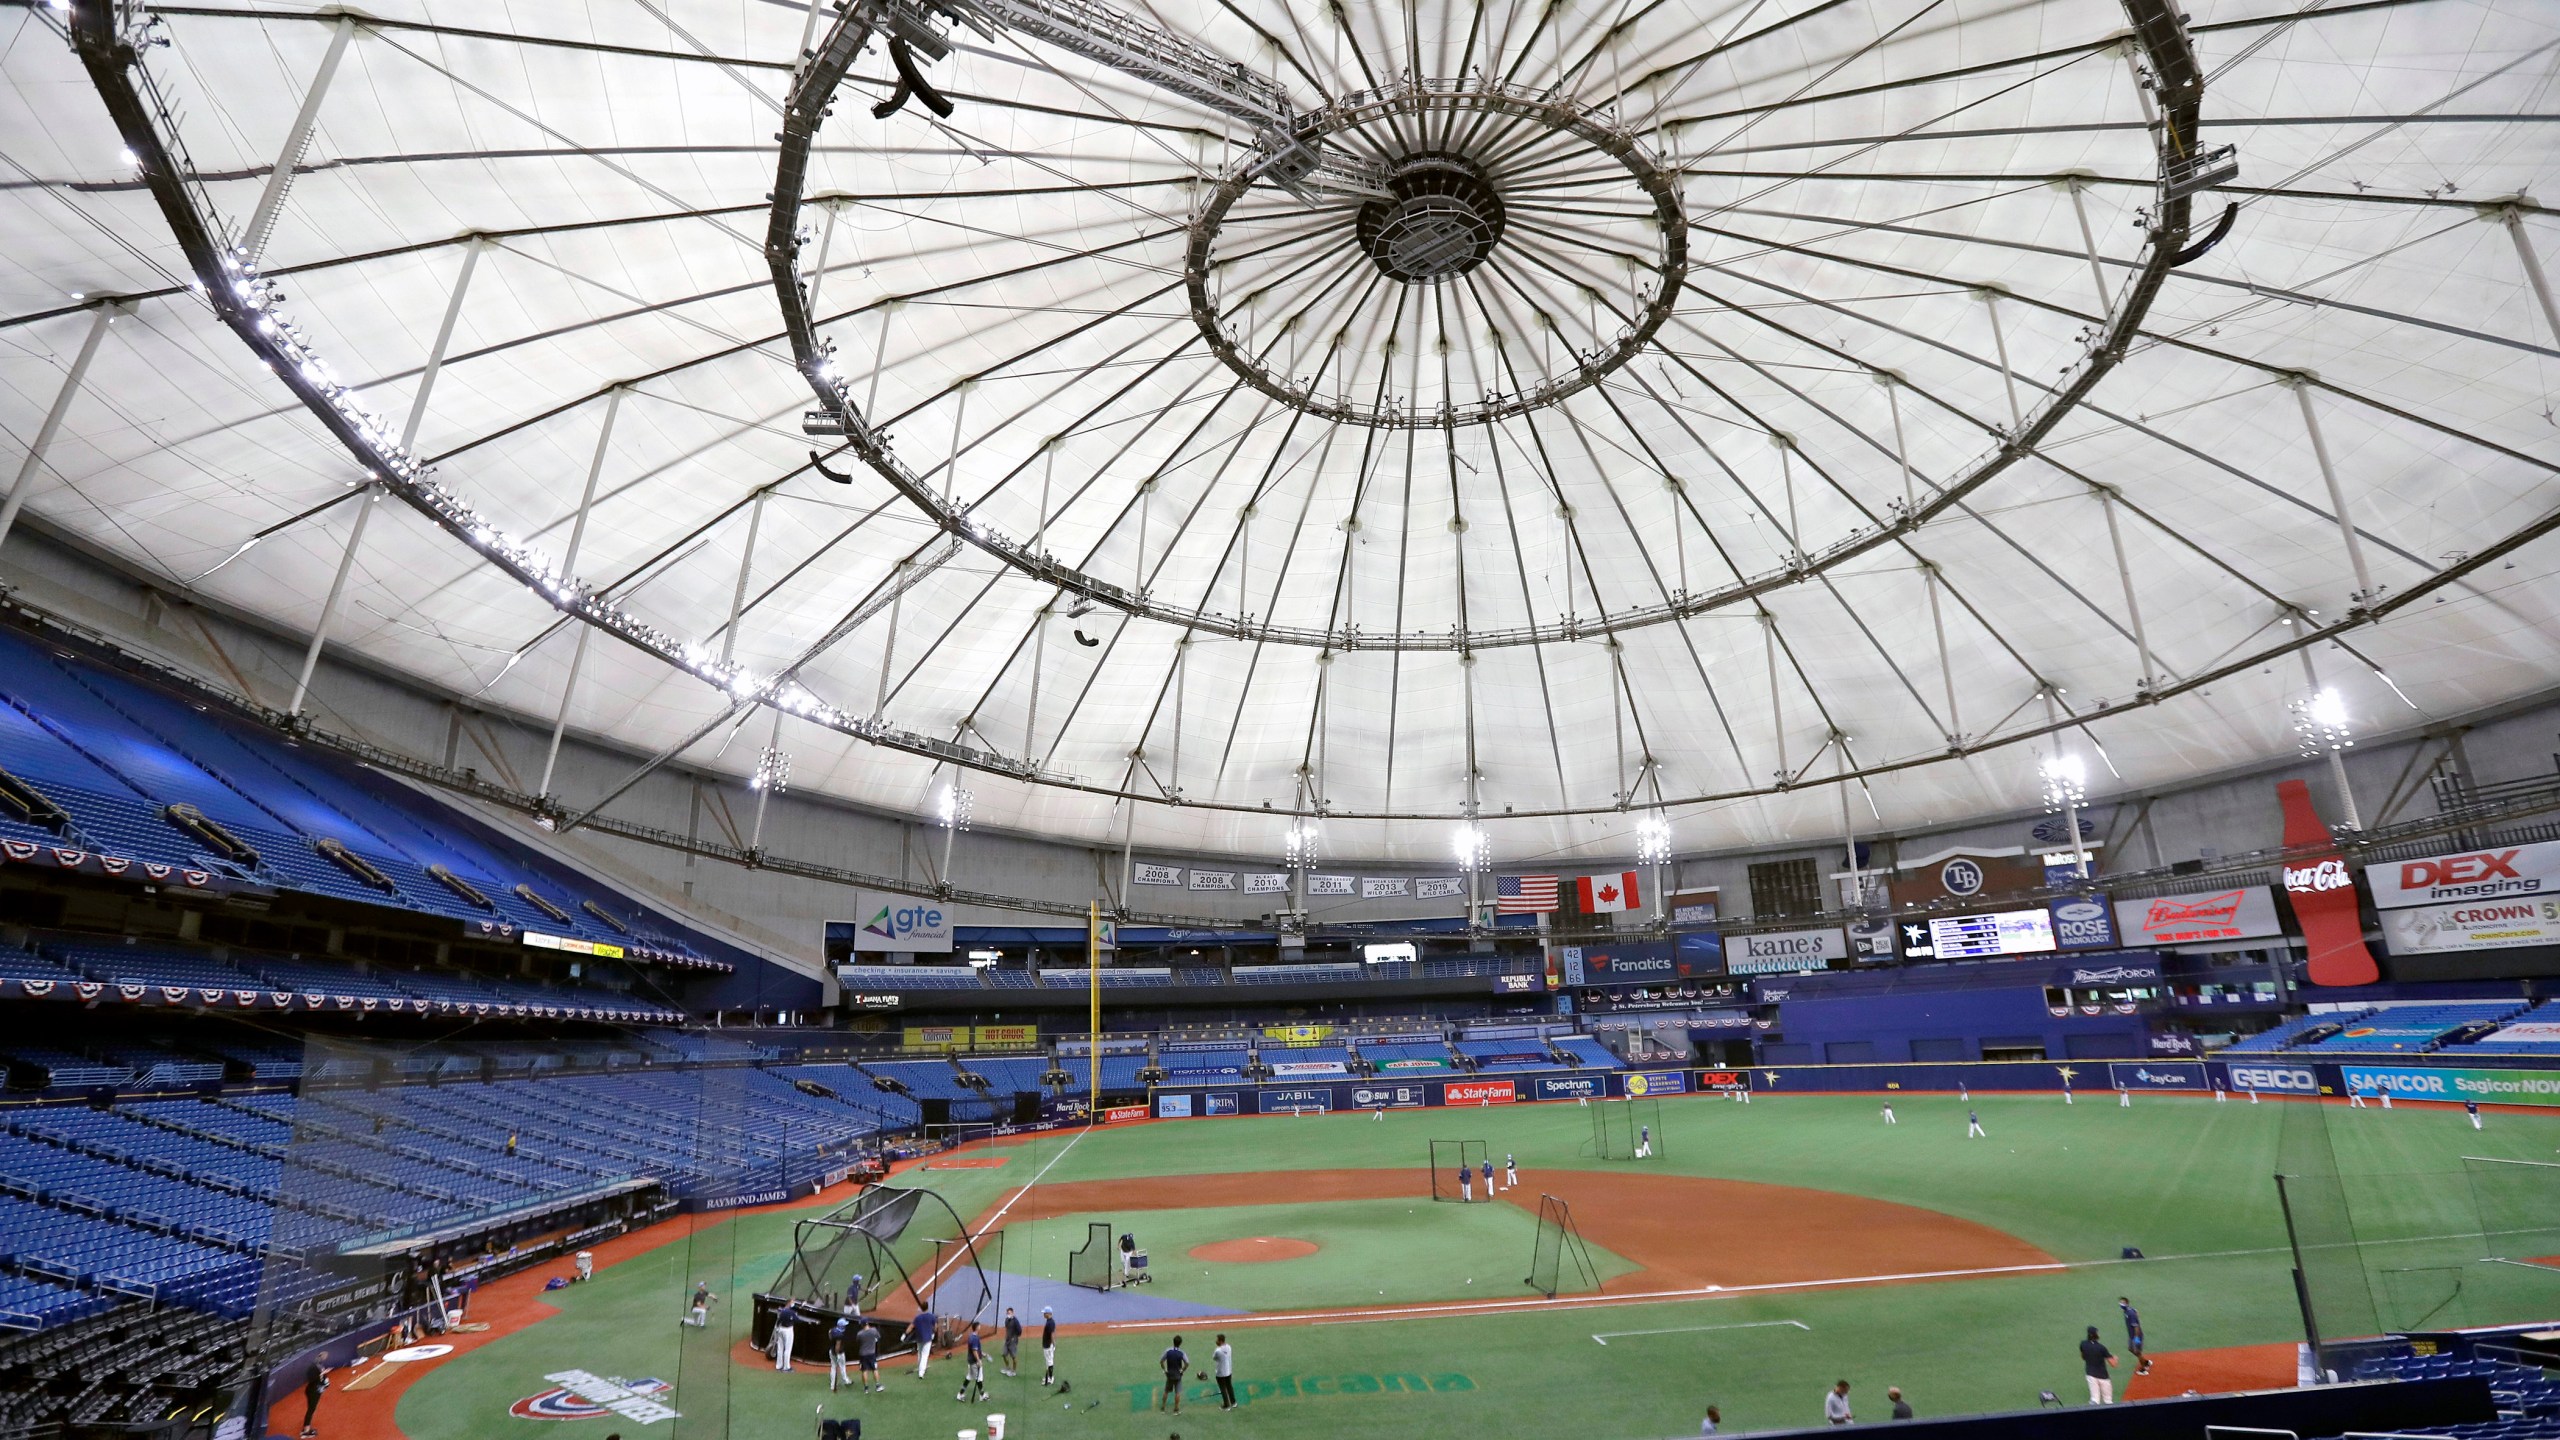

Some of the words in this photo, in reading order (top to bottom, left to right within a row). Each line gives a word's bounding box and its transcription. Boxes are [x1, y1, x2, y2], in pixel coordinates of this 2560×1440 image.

[1145, 870, 1169, 879] 2008
[2401, 849, 2521, 890] DEX
[1200, 876, 1224, 884] 2008
[1949, 866, 1978, 889] TB
[2283, 860, 2352, 893] Coca-Cola
[1320, 881, 1342, 889] 2011
[2430, 878, 2541, 899] imaging
[896, 905, 942, 933] gte
[2148, 905, 2237, 922] Budweiser
[2454, 904, 2535, 924] CROWN
[2059, 920, 2110, 936] ROSE
[904, 929, 947, 941] financial
[2063, 935, 2110, 945] RADIOLOGY
[1746, 936, 1823, 957] kane's
[1568, 950, 1578, 959] 42
[1570, 962, 1578, 970] 12
[1612, 957, 1672, 972] Fanatics
[1500, 974, 1535, 982] REPUBLIC
[1570, 974, 1581, 982] 66
[2120, 968, 2156, 979] PORCH
[924, 1033, 952, 1042] LOUISIANA
[986, 1029, 1000, 1040] HOT
[2152, 1038, 2171, 1048] Hard
[2171, 1038, 2192, 1050] Rock
[1703, 1072, 1740, 1084] DEX
[2233, 1068, 2314, 1089] GEICO
[2350, 1073, 2446, 1093] SAGICOR
[1546, 1080, 1592, 1092] Spectrum
[1277, 1092, 1316, 1100] JABIL
[1374, 1092, 1390, 1100] SUN
[1463, 1088, 1488, 1099] State
[1488, 1087, 1512, 1098] Farm
[1056, 1102, 1074, 1112] Hard
[1074, 1102, 1090, 1112] Rock
[1216, 1099, 1234, 1107] RIPA
[1117, 1111, 1131, 1120] State
[1131, 1110, 1144, 1118] Farm
[706, 1194, 756, 1209] RAYMOND
[756, 1190, 787, 1203] JAMES
